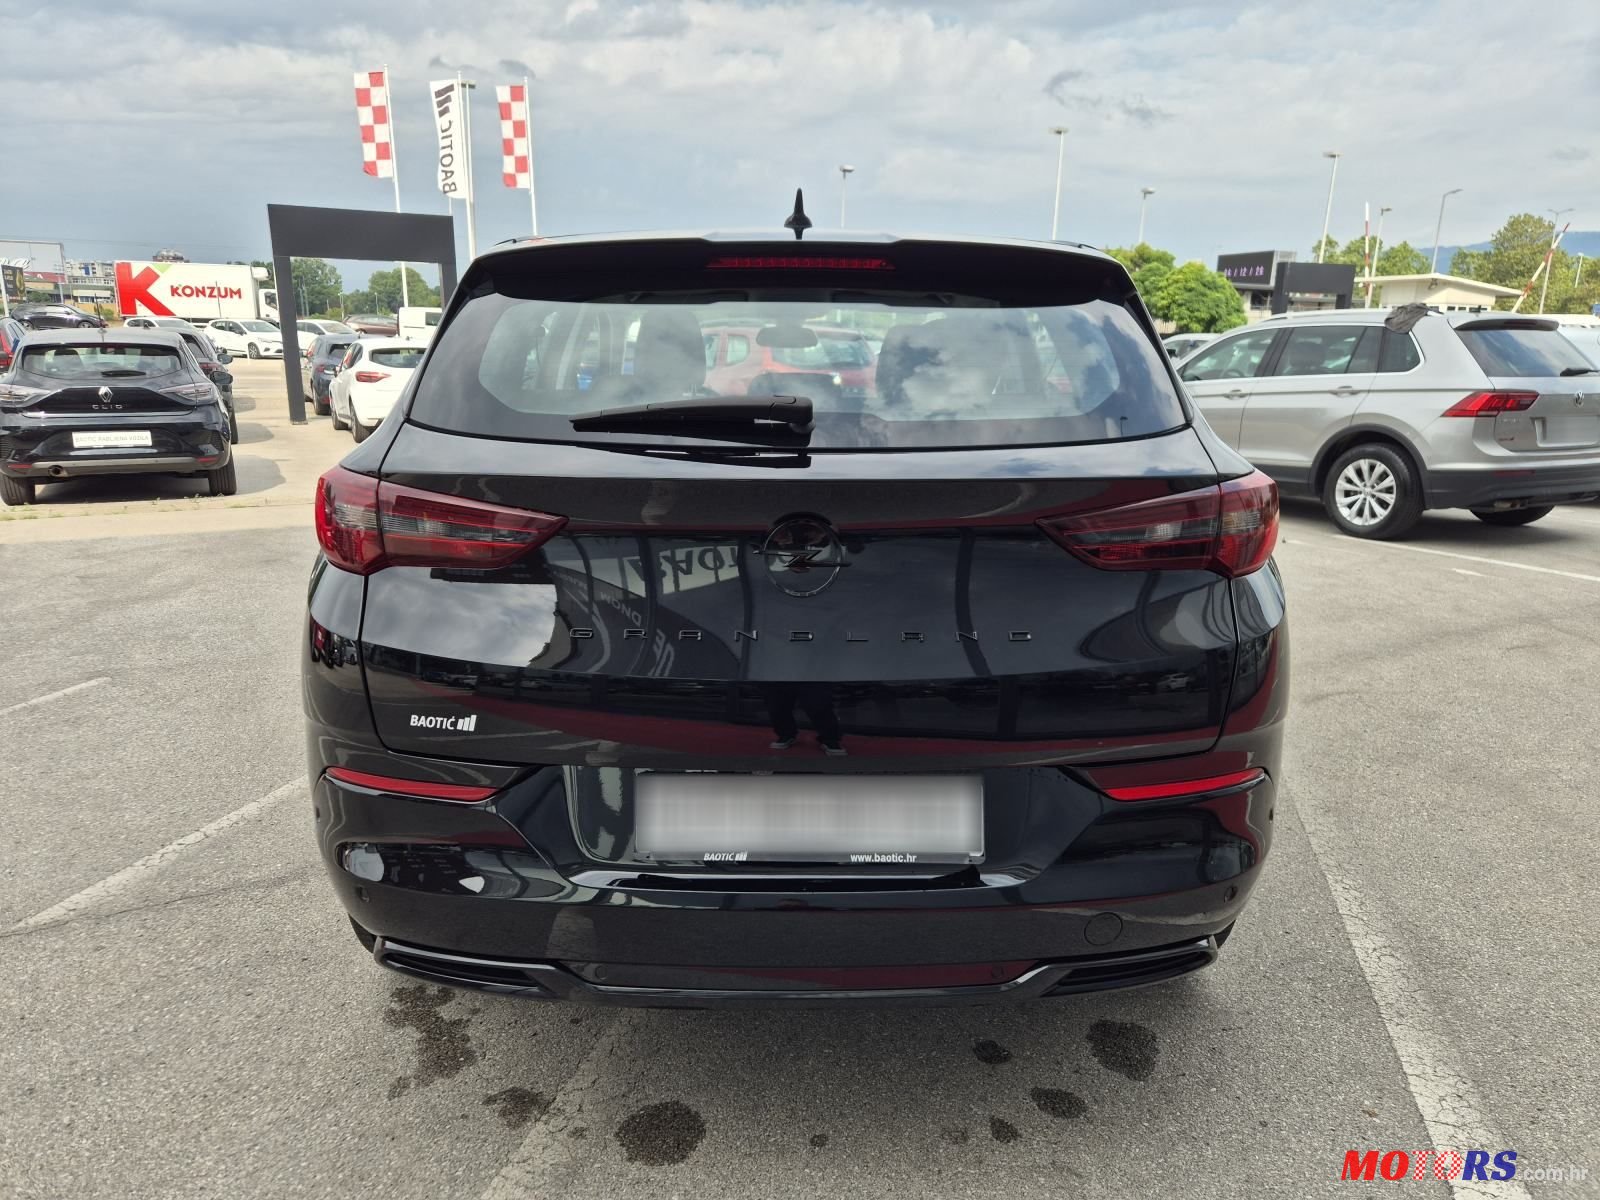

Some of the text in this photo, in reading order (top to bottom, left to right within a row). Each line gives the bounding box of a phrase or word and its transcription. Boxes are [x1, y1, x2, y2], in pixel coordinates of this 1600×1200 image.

[116, 262, 176, 316] K
[170, 285, 242, 299] KONZUM
[570, 627, 1033, 642] GRANDLAND
[410, 714, 456, 730] BAOTIĆ
[850, 852, 918, 863] www.baotic.hr
